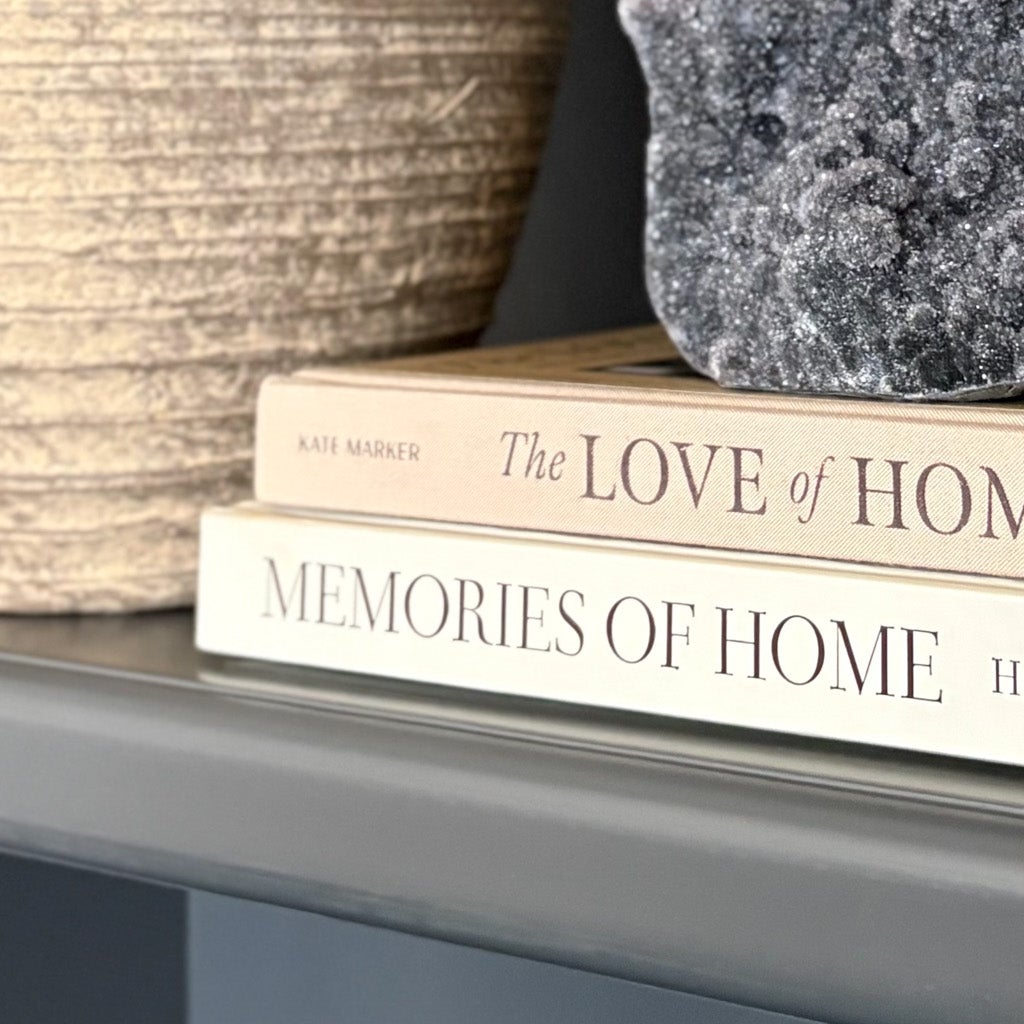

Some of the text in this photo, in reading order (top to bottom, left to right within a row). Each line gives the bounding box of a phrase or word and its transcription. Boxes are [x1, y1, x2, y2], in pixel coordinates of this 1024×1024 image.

[298, 434, 421, 463] KATE MARKER
[500, 431, 567, 482] The
[579, 433, 768, 516] LOVE
[790, 455, 835, 524] of
[260, 556, 943, 705] MEMORIES OF HOME
